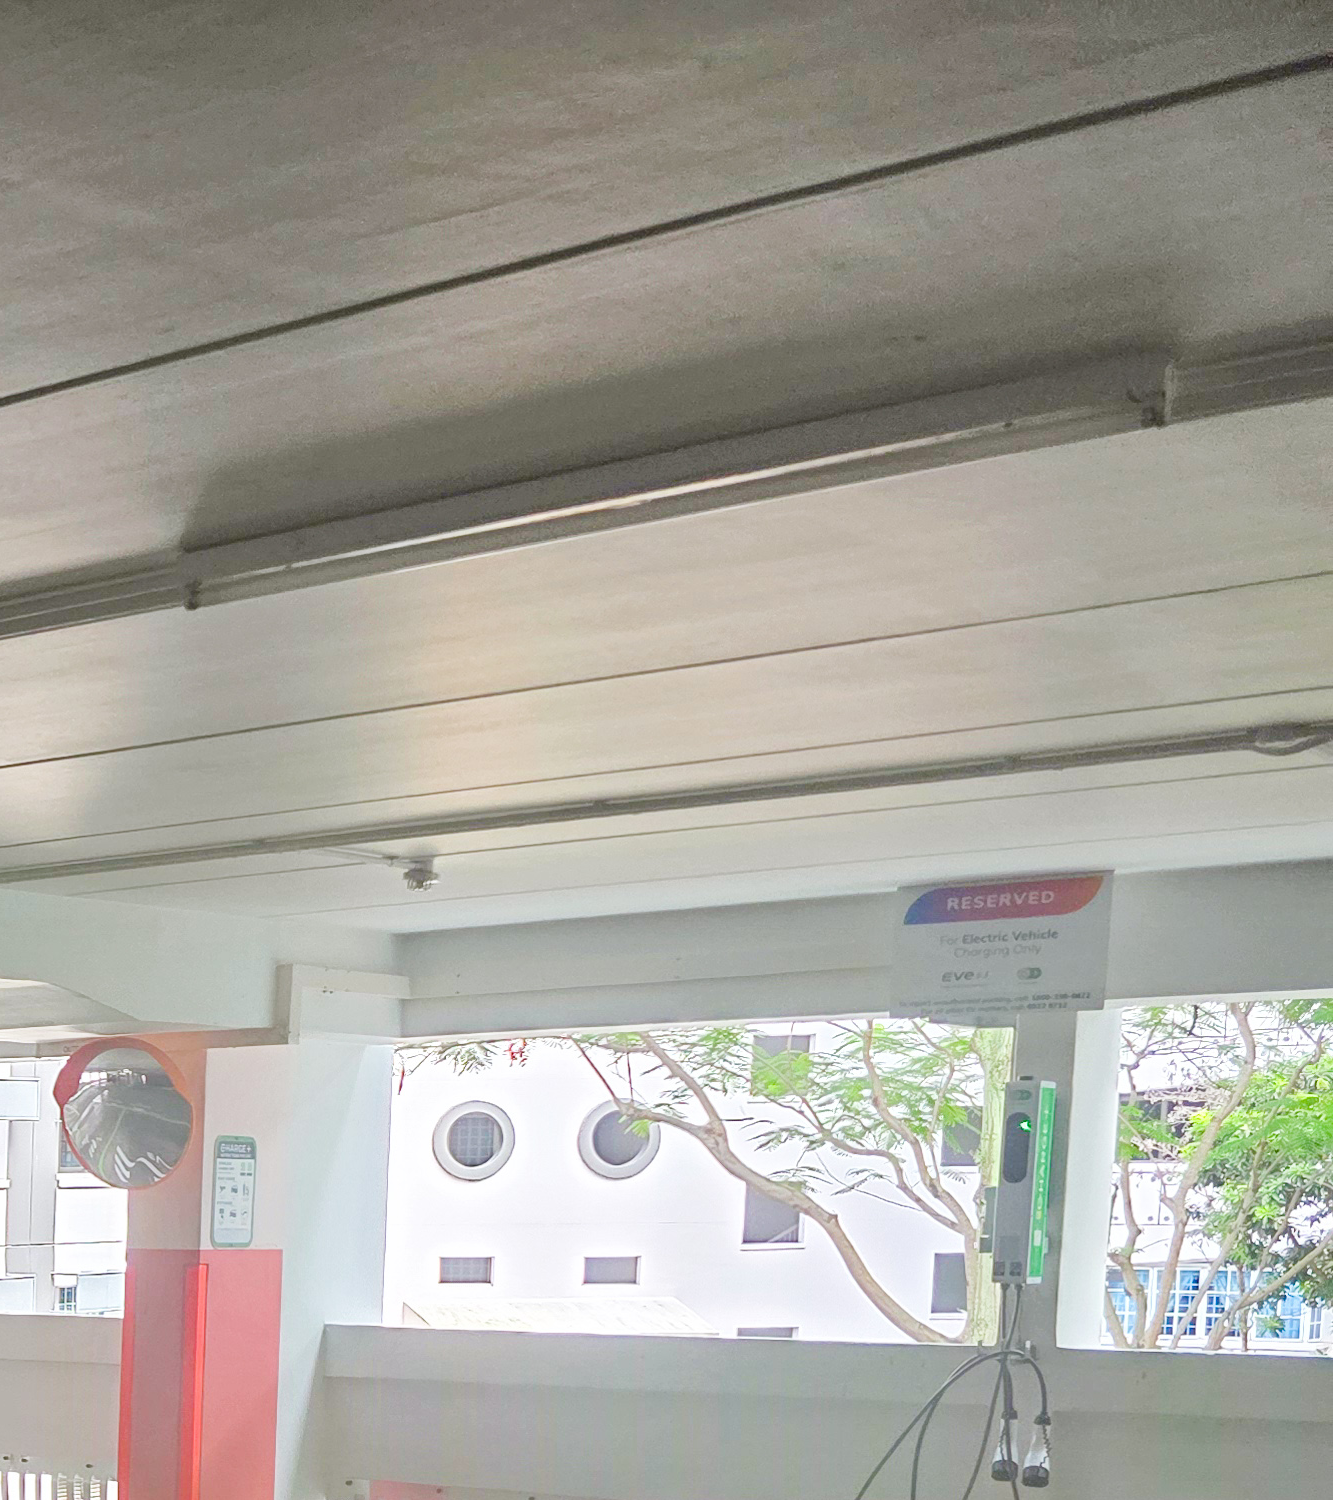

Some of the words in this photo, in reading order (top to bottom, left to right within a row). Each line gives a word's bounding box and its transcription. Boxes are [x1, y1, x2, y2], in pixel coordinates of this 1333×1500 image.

[947, 890, 1055, 911] RESERVED
[962, 932, 1008, 944] Electric
[1012, 929, 1059, 942] Vehicle
